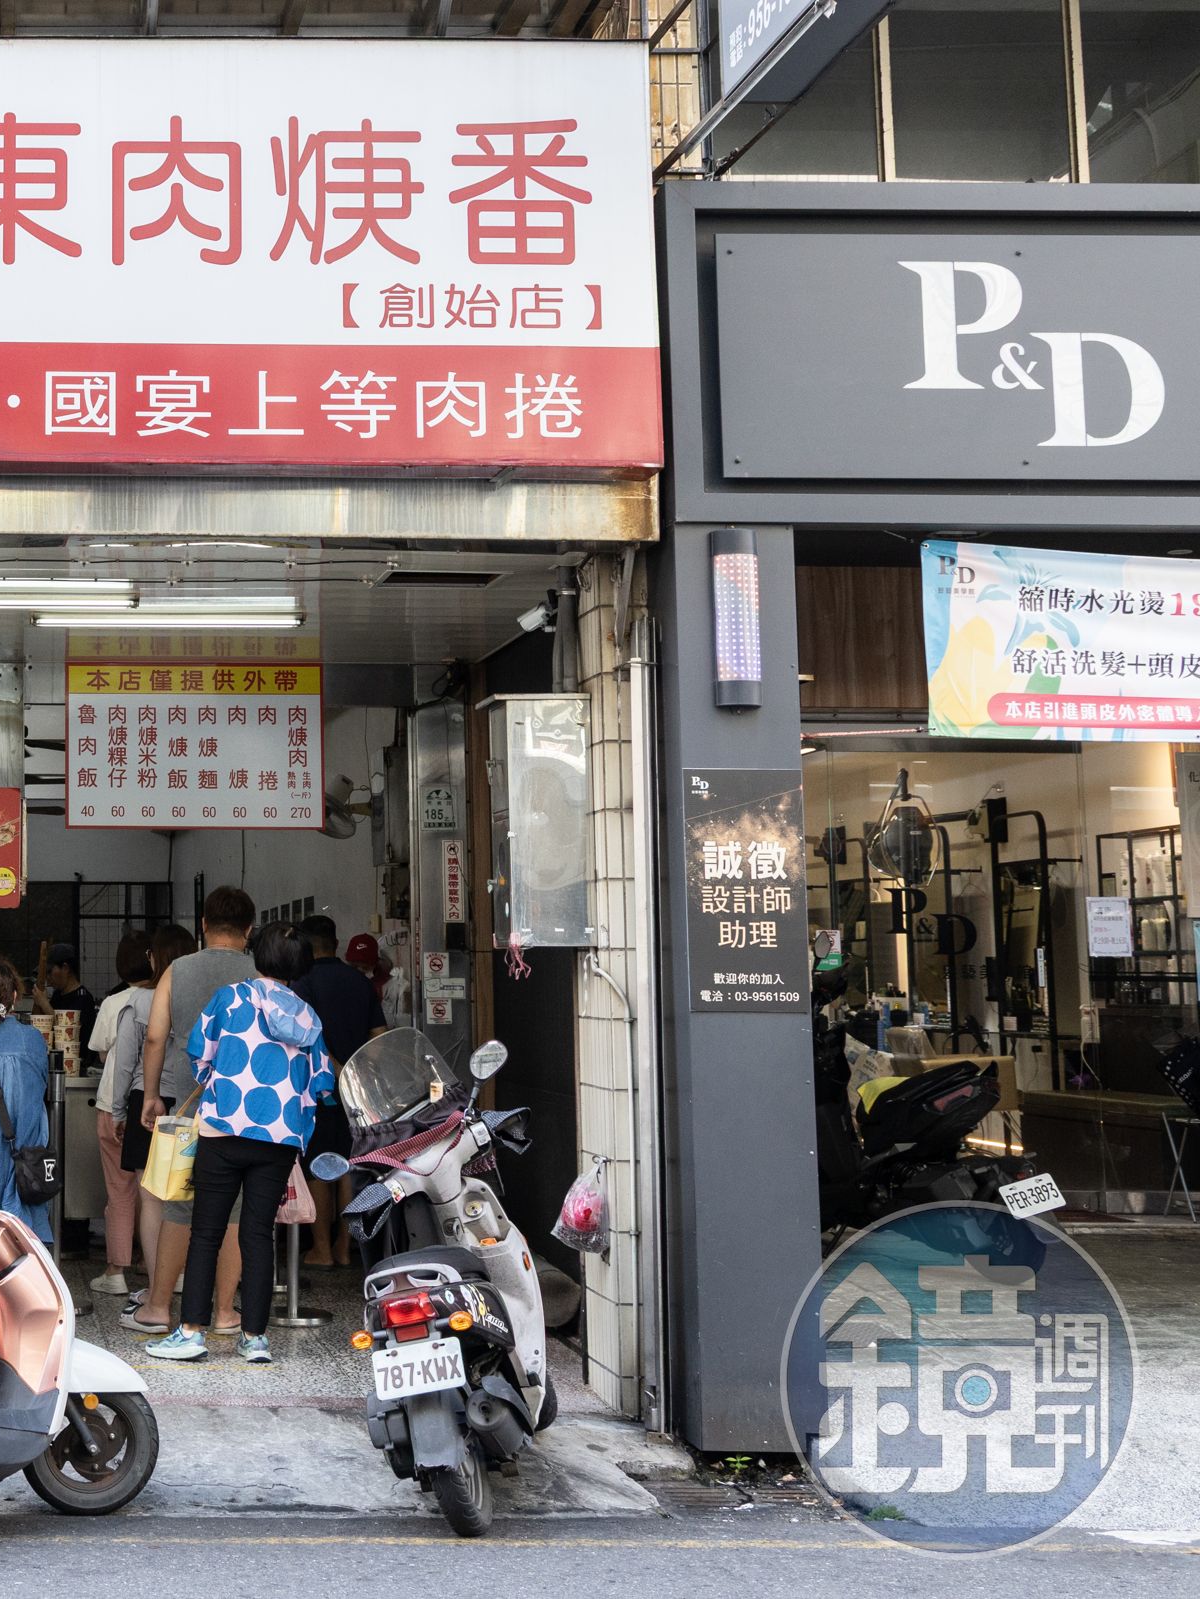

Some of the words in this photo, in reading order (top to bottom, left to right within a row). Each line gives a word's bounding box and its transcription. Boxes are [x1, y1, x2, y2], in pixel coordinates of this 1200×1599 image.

[86, 669, 298, 691] 本店僅提供外帶
[1005, 701, 1200, 723] 本店引進頭皮外密體導
[77, 704, 98, 789] 魯肉飯
[137, 704, 157, 789] 肉焿米粉
[167, 705, 188, 789] 肉焿飯
[198, 705, 218, 789] 肉焿麵
[80, 805, 95, 817] 40
[111, 805, 125, 817] 60
[141, 805, 155, 817] 60
[171, 806, 186, 818] 60
[202, 806, 216, 818] 60
[233, 806, 247, 818] 60
[263, 806, 277, 818] 60
[290, 806, 311, 819] 270
[702, 840, 788, 880] 誠徵
[701, 886, 791, 914] 設計師
[718, 920, 778, 948] 助理
[713, 973, 785, 985] 歡迎你的加入
